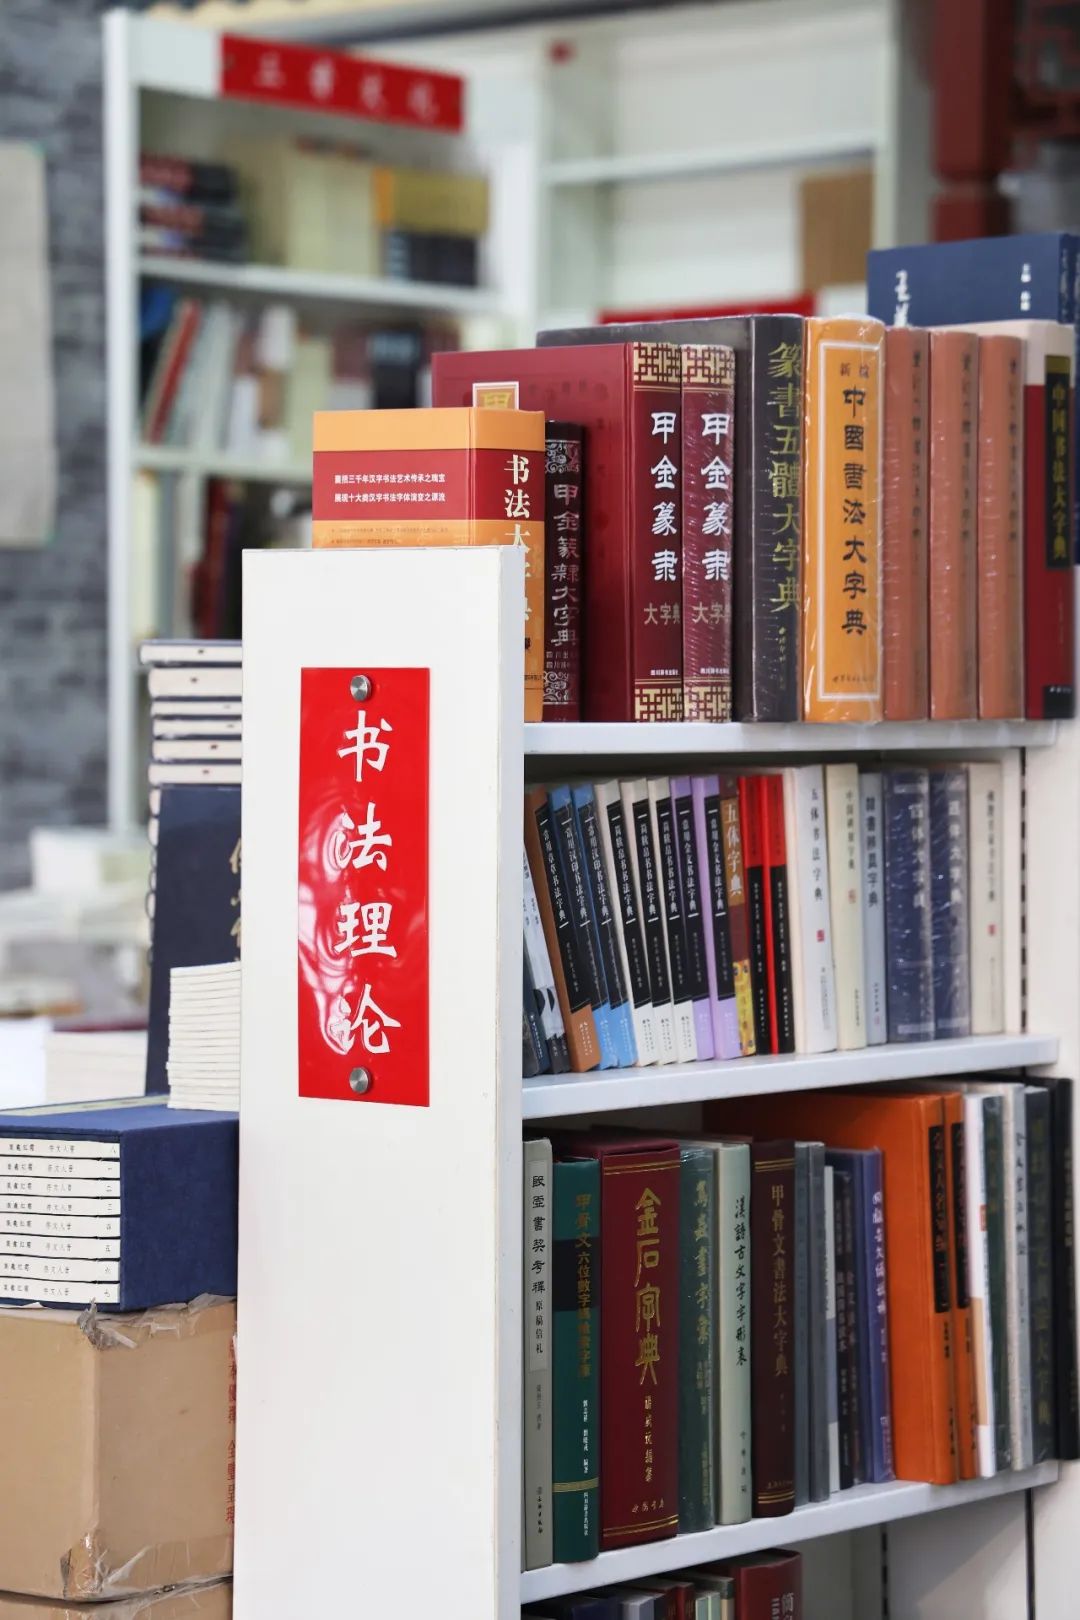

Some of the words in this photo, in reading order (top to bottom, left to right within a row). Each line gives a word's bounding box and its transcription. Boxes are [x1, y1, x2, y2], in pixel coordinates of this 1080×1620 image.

[841, 388, 869, 636] 中國書法大字典
[327, 709, 401, 1056] 书法理论
[634, 1187, 662, 1386] 金石字典
